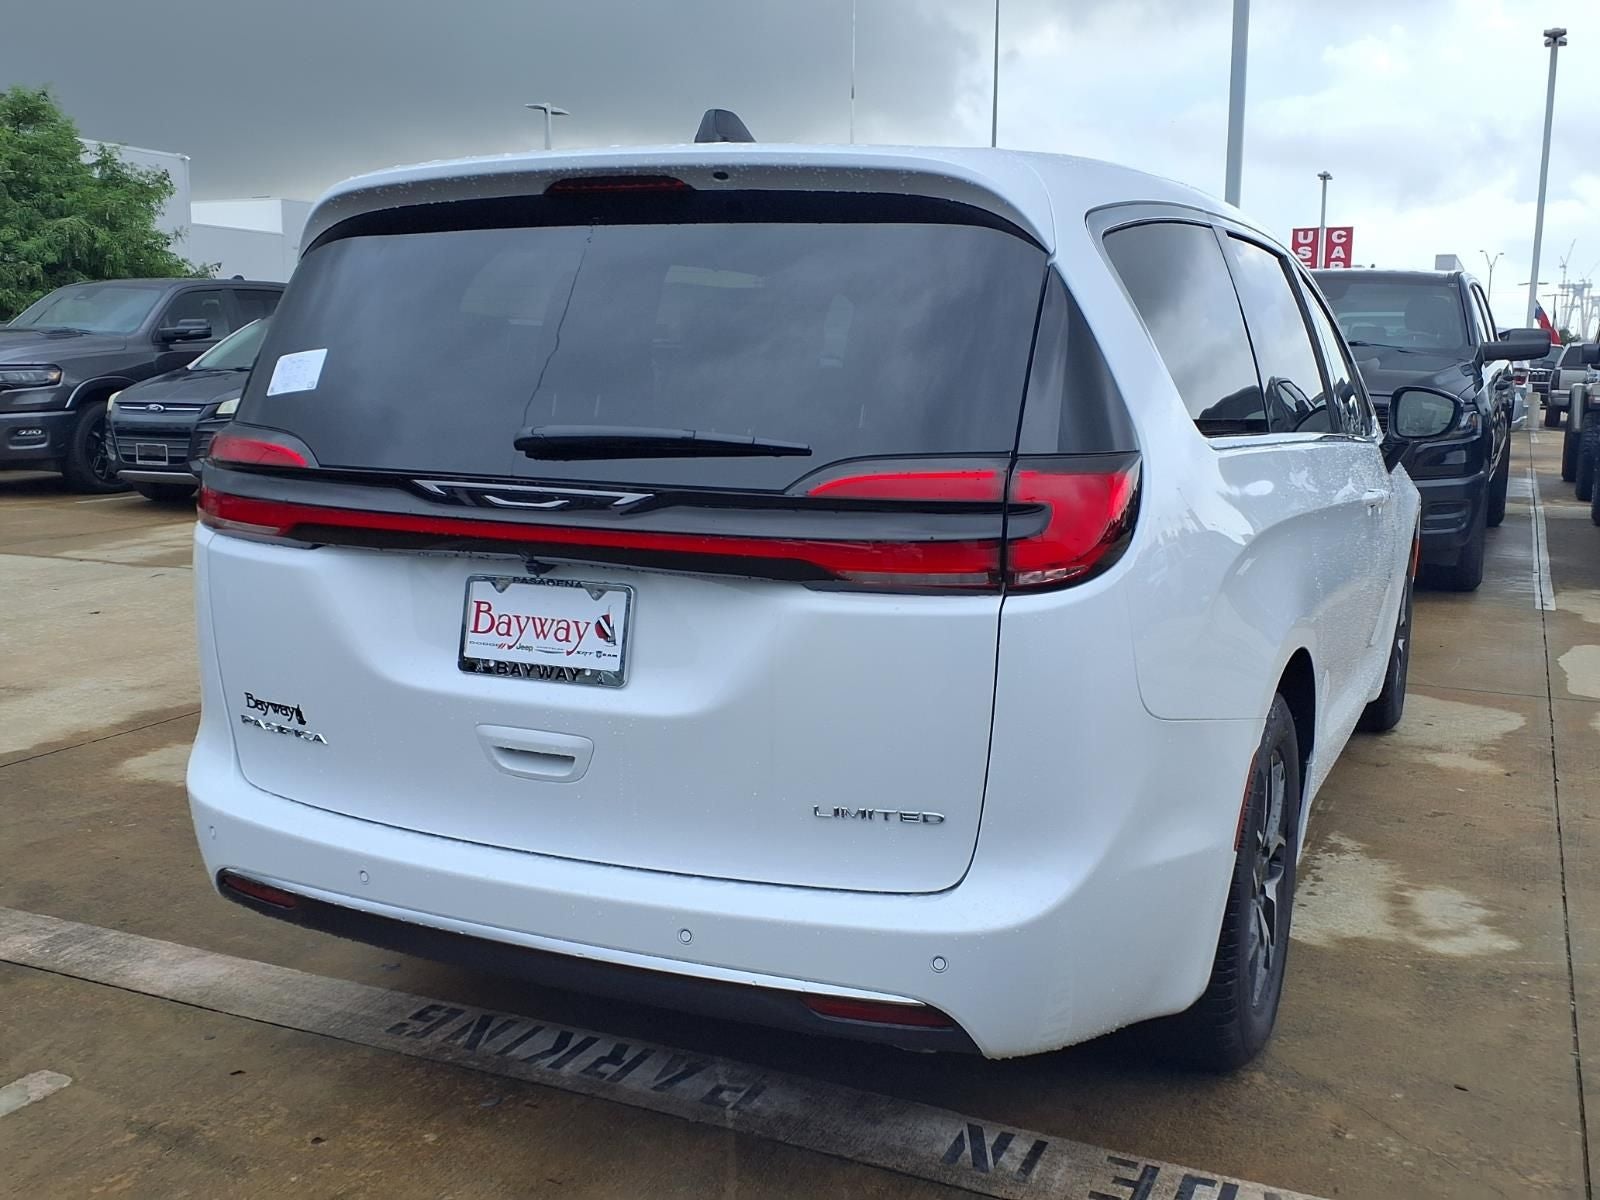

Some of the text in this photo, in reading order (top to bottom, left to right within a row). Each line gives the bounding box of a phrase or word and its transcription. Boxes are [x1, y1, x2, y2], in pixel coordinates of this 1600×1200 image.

[512, 576, 583, 588] PASADENA
[470, 600, 591, 656] Bayway
[516, 643, 534, 652] Jeep
[496, 660, 581, 681] BAYWAY
[244, 692, 297, 722] Bayway
[813, 805, 945, 825] LIMITED
[384, 1002, 767, 1115] PARKING
